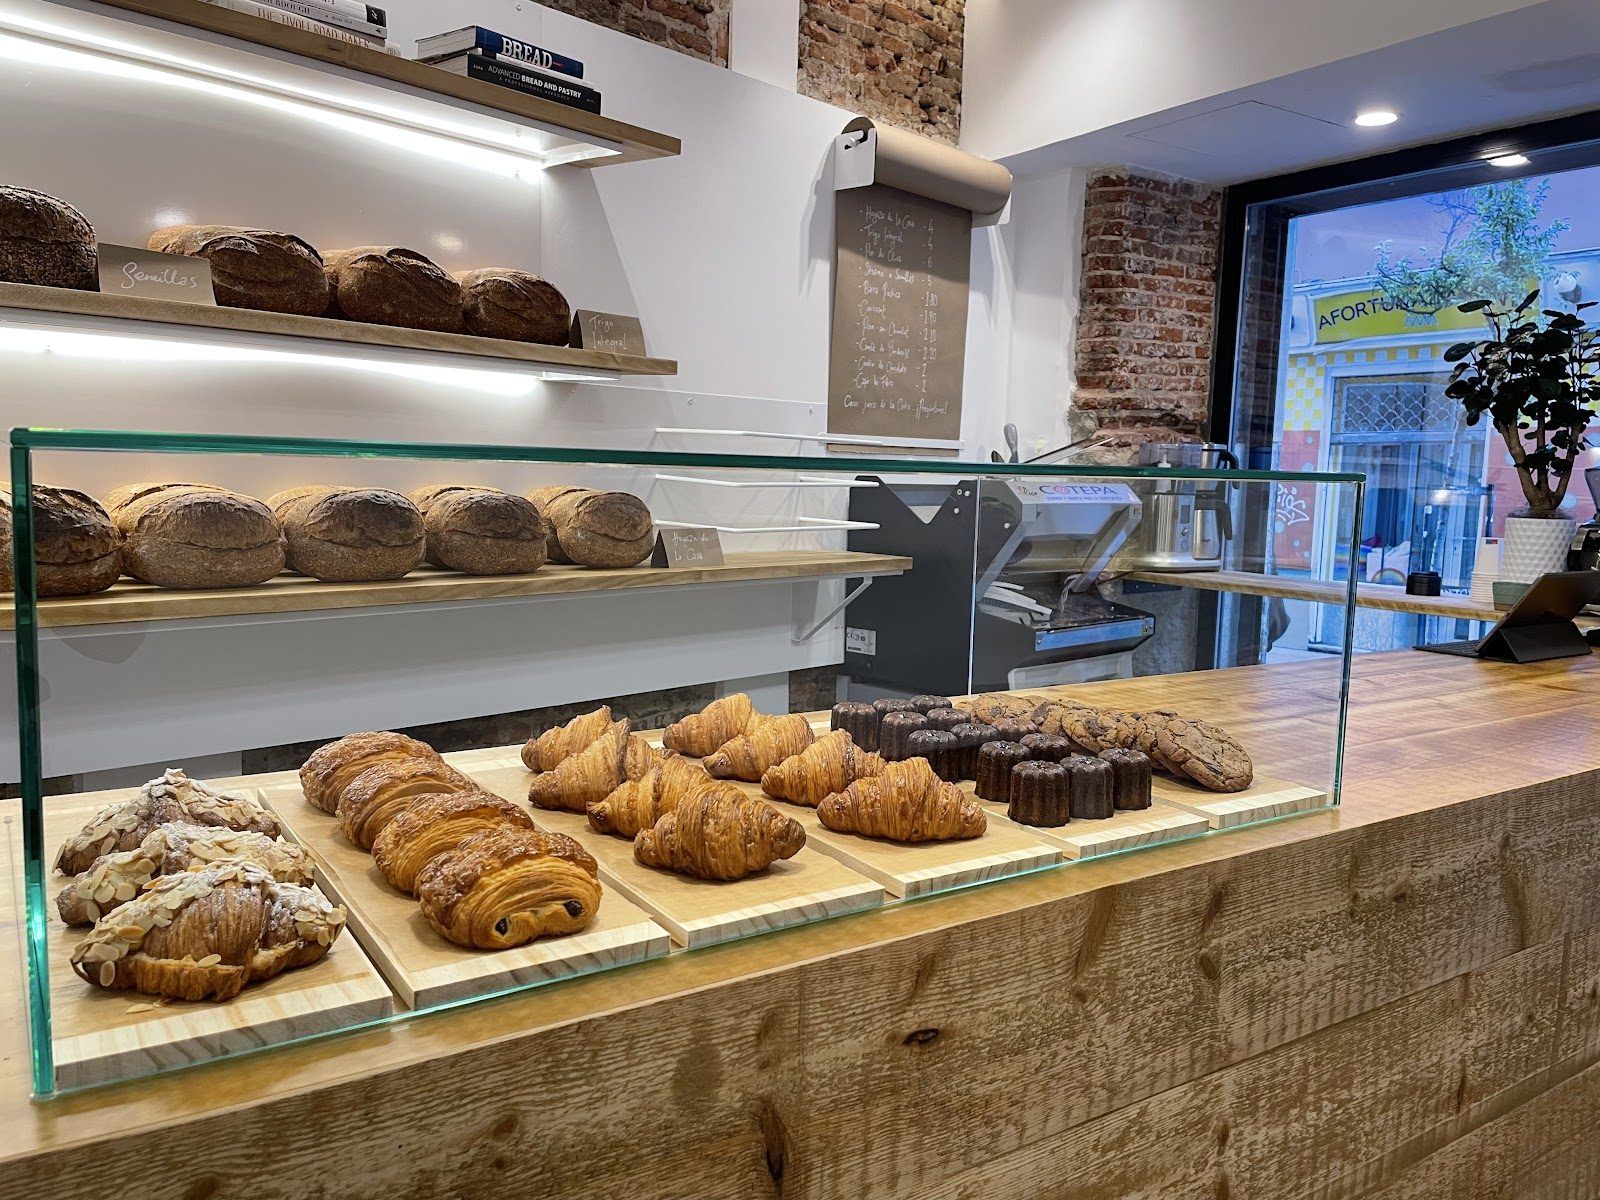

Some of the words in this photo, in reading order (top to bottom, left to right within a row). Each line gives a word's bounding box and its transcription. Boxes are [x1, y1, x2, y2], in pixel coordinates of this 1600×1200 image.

[501, 37, 553, 69] BREAD
[488, 65, 521, 80] ADVANCED
[521, 75, 543, 87] BREAD
[543, 82, 558, 92] AND
[558, 86, 582, 99] PASTRY
[121, 261, 198, 289] Semillas
[589, 314, 614, 333] Trigo
[592, 331, 628, 354] Integral
[1039, 485, 1118, 496] COTEPA
